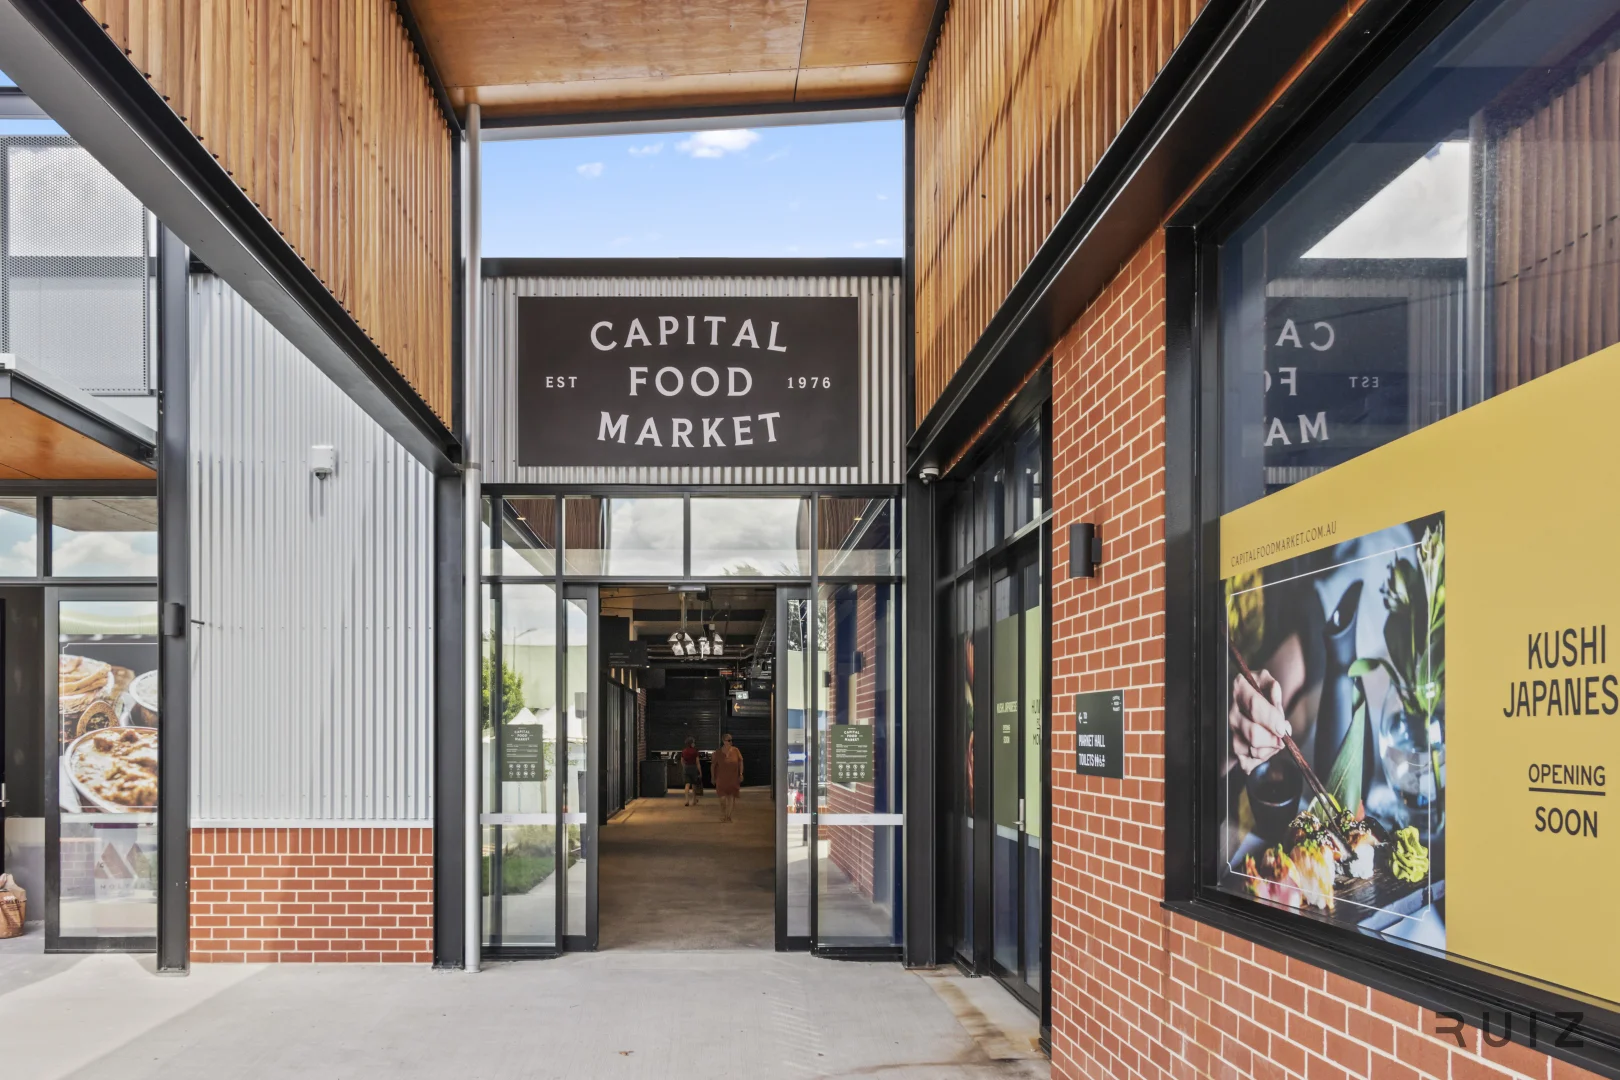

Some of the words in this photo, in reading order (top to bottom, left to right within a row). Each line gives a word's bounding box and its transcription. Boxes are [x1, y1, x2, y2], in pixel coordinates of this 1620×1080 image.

[590, 315, 788, 353] CAPITAL
[545, 376, 578, 389] EST
[629, 366, 753, 397] FOOD
[787, 377, 831, 389] 1976
[597, 411, 781, 448] MARKET
[1230, 520, 1337, 568] CAPITALFOODMARKET.COM.AU
[1528, 624, 1606, 670] KUSHI
[1503, 674, 1619, 718] JAPANES
[1078, 734, 1094, 747] MARKET
[1094, 734, 1106, 748] HALL
[1078, 753, 1094, 767] TOILETS
[1528, 763, 1606, 787] OPENING
[1534, 806, 1598, 838] SOON
